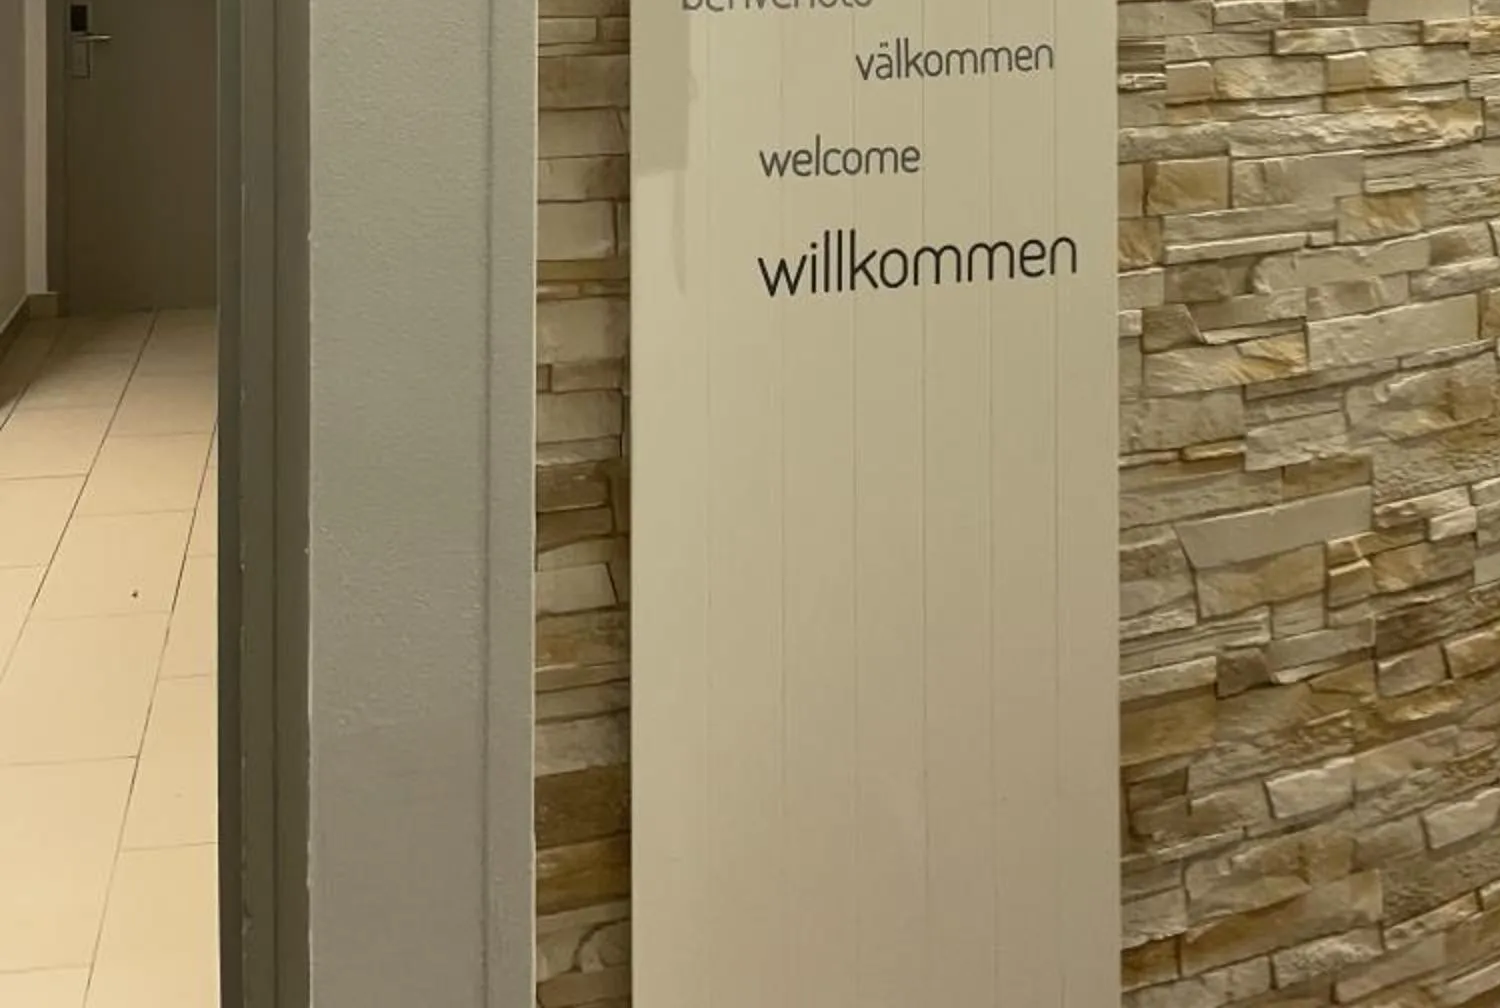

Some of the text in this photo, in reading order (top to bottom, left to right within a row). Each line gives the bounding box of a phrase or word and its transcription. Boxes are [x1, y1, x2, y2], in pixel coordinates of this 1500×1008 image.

[855, 37, 1055, 81] välkommen
[758, 134, 921, 178] welcome
[757, 228, 1078, 297] willkommen
